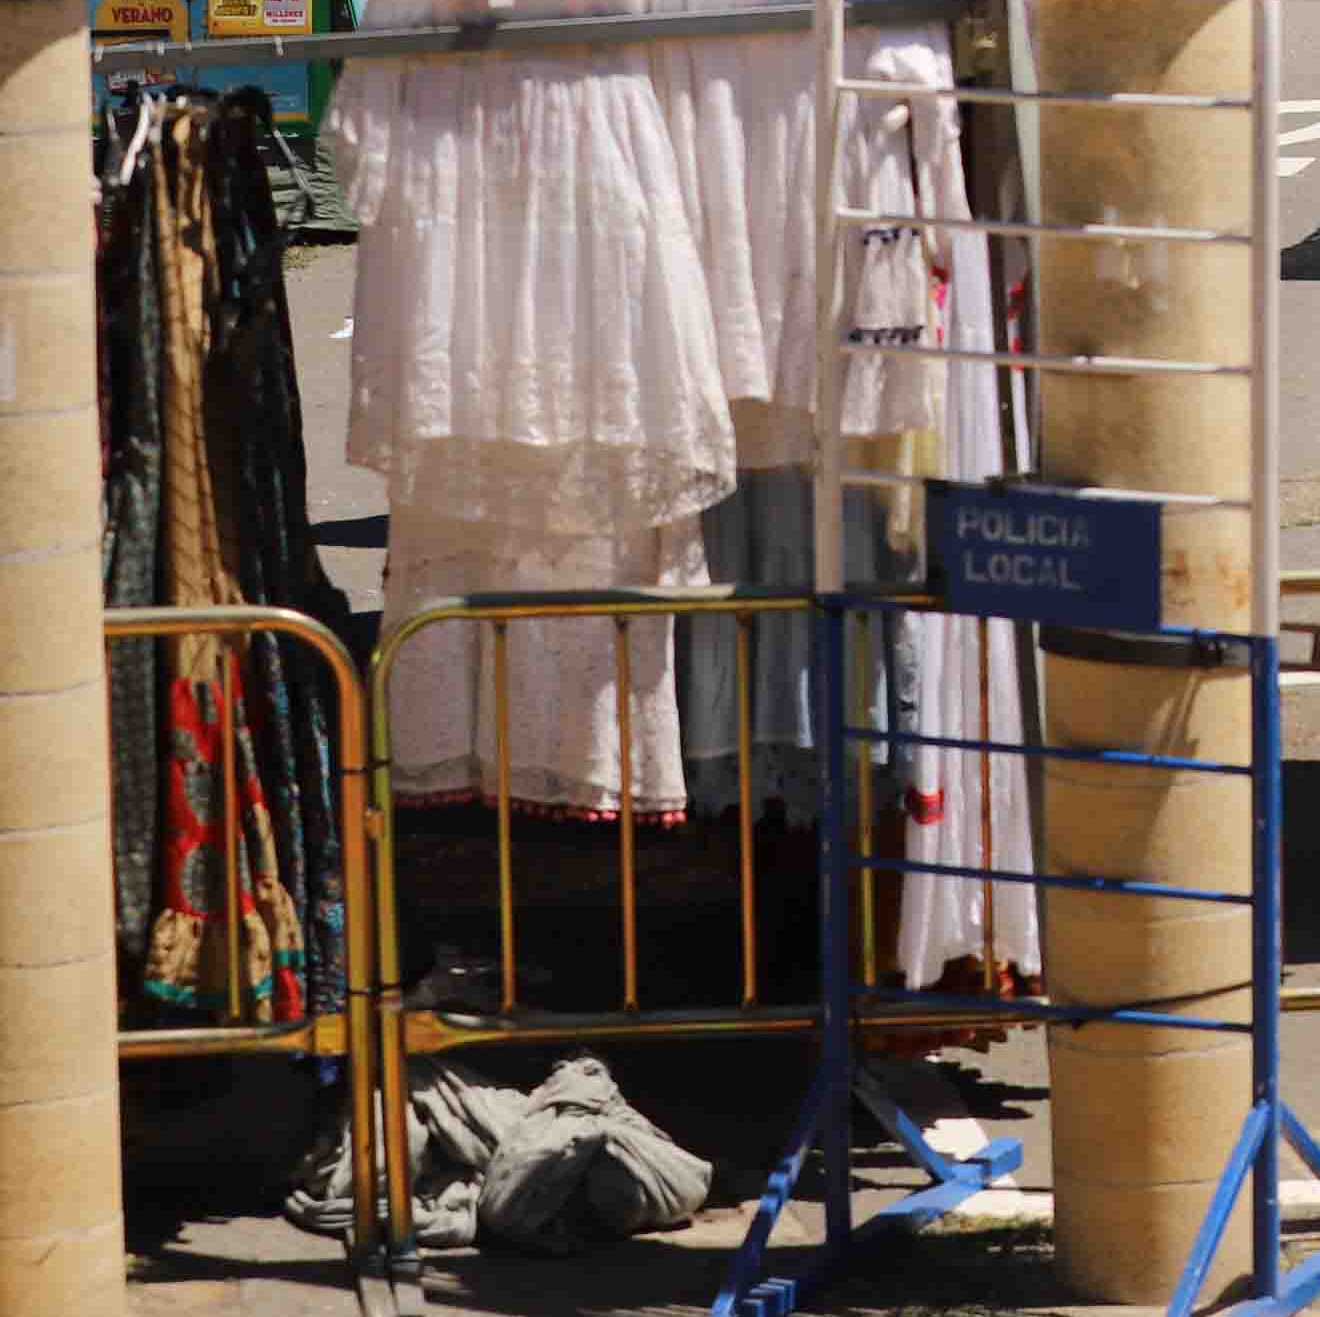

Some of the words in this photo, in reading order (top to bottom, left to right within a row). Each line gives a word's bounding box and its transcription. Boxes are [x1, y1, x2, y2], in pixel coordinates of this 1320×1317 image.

[112, 7, 174, 23] VERANO
[957, 507, 1089, 546] POLICIA
[963, 550, 1084, 591] LOCAL
